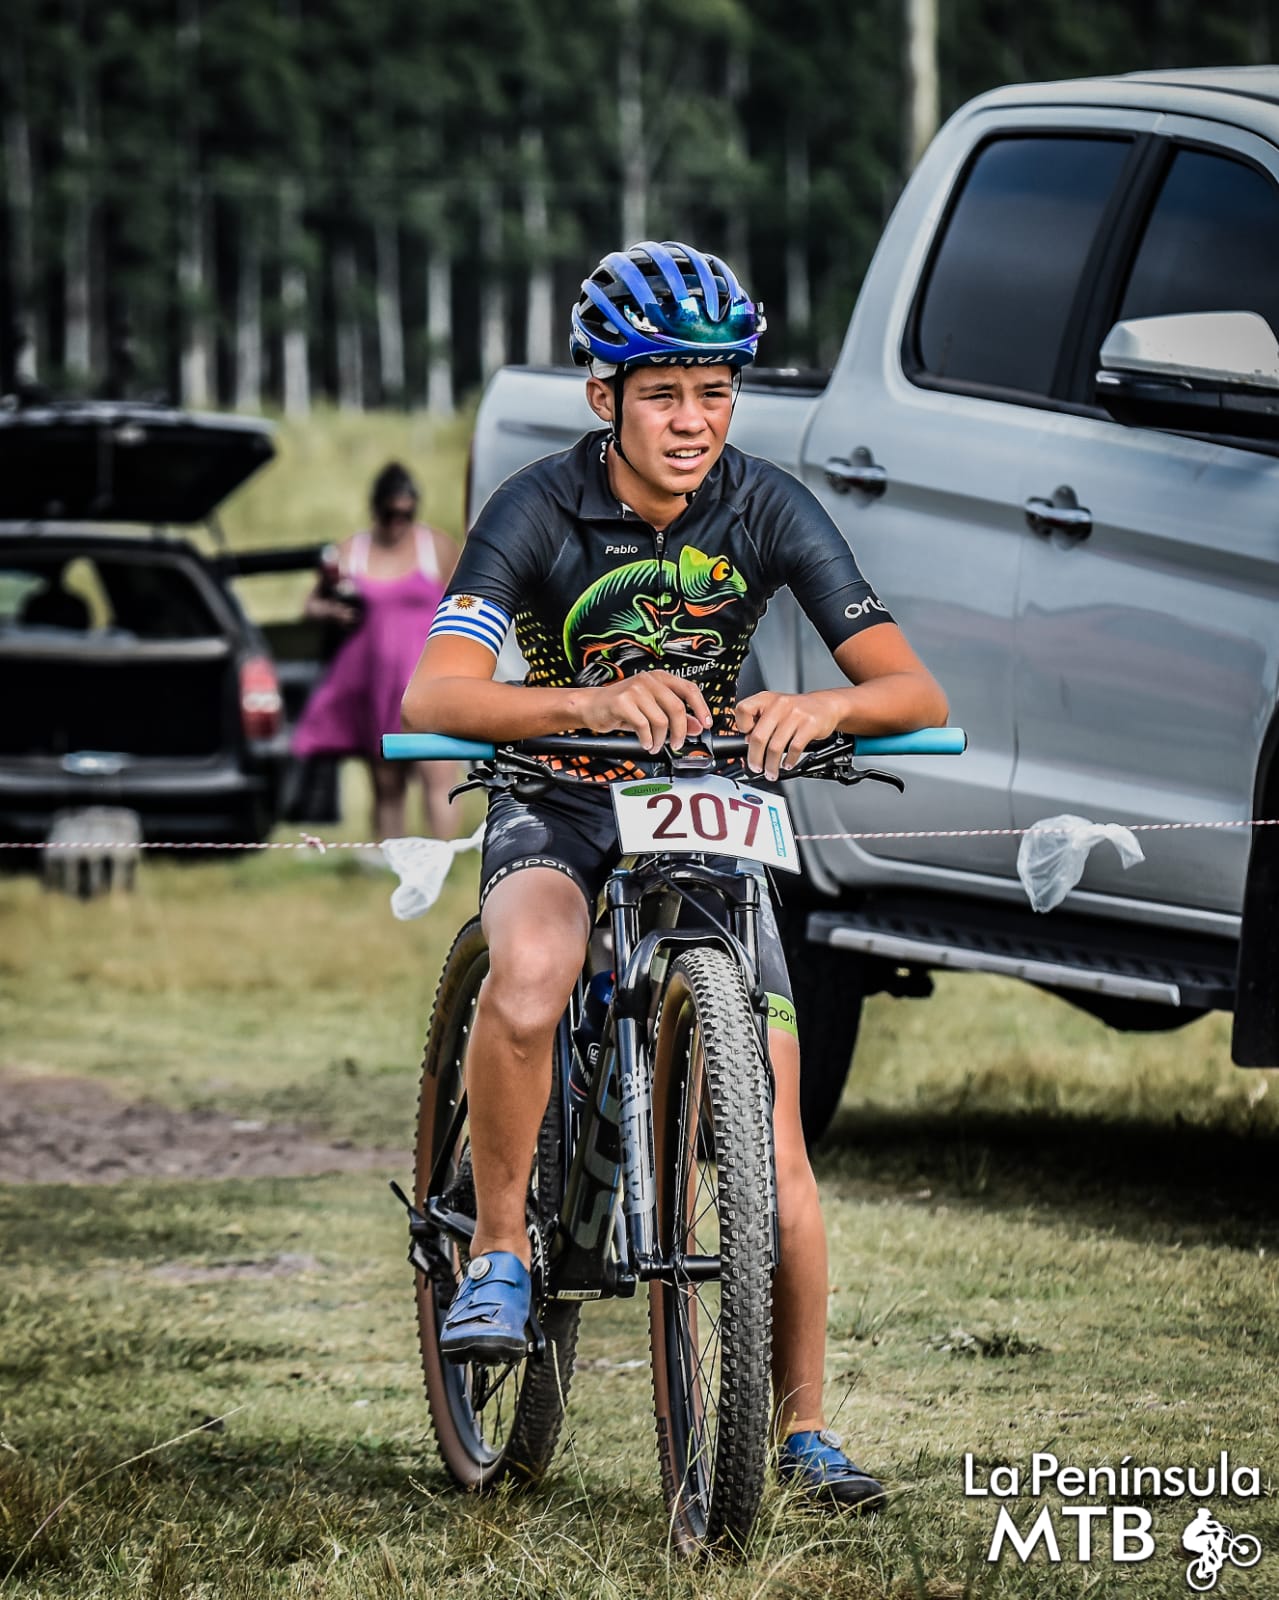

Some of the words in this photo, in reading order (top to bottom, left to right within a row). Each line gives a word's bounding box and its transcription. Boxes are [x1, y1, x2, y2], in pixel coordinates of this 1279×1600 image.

[649, 353, 736, 364] ITALIA
[605, 544, 638, 554] Pablo
[647, 792, 761, 847] 207
[511, 858, 573, 877] sport
